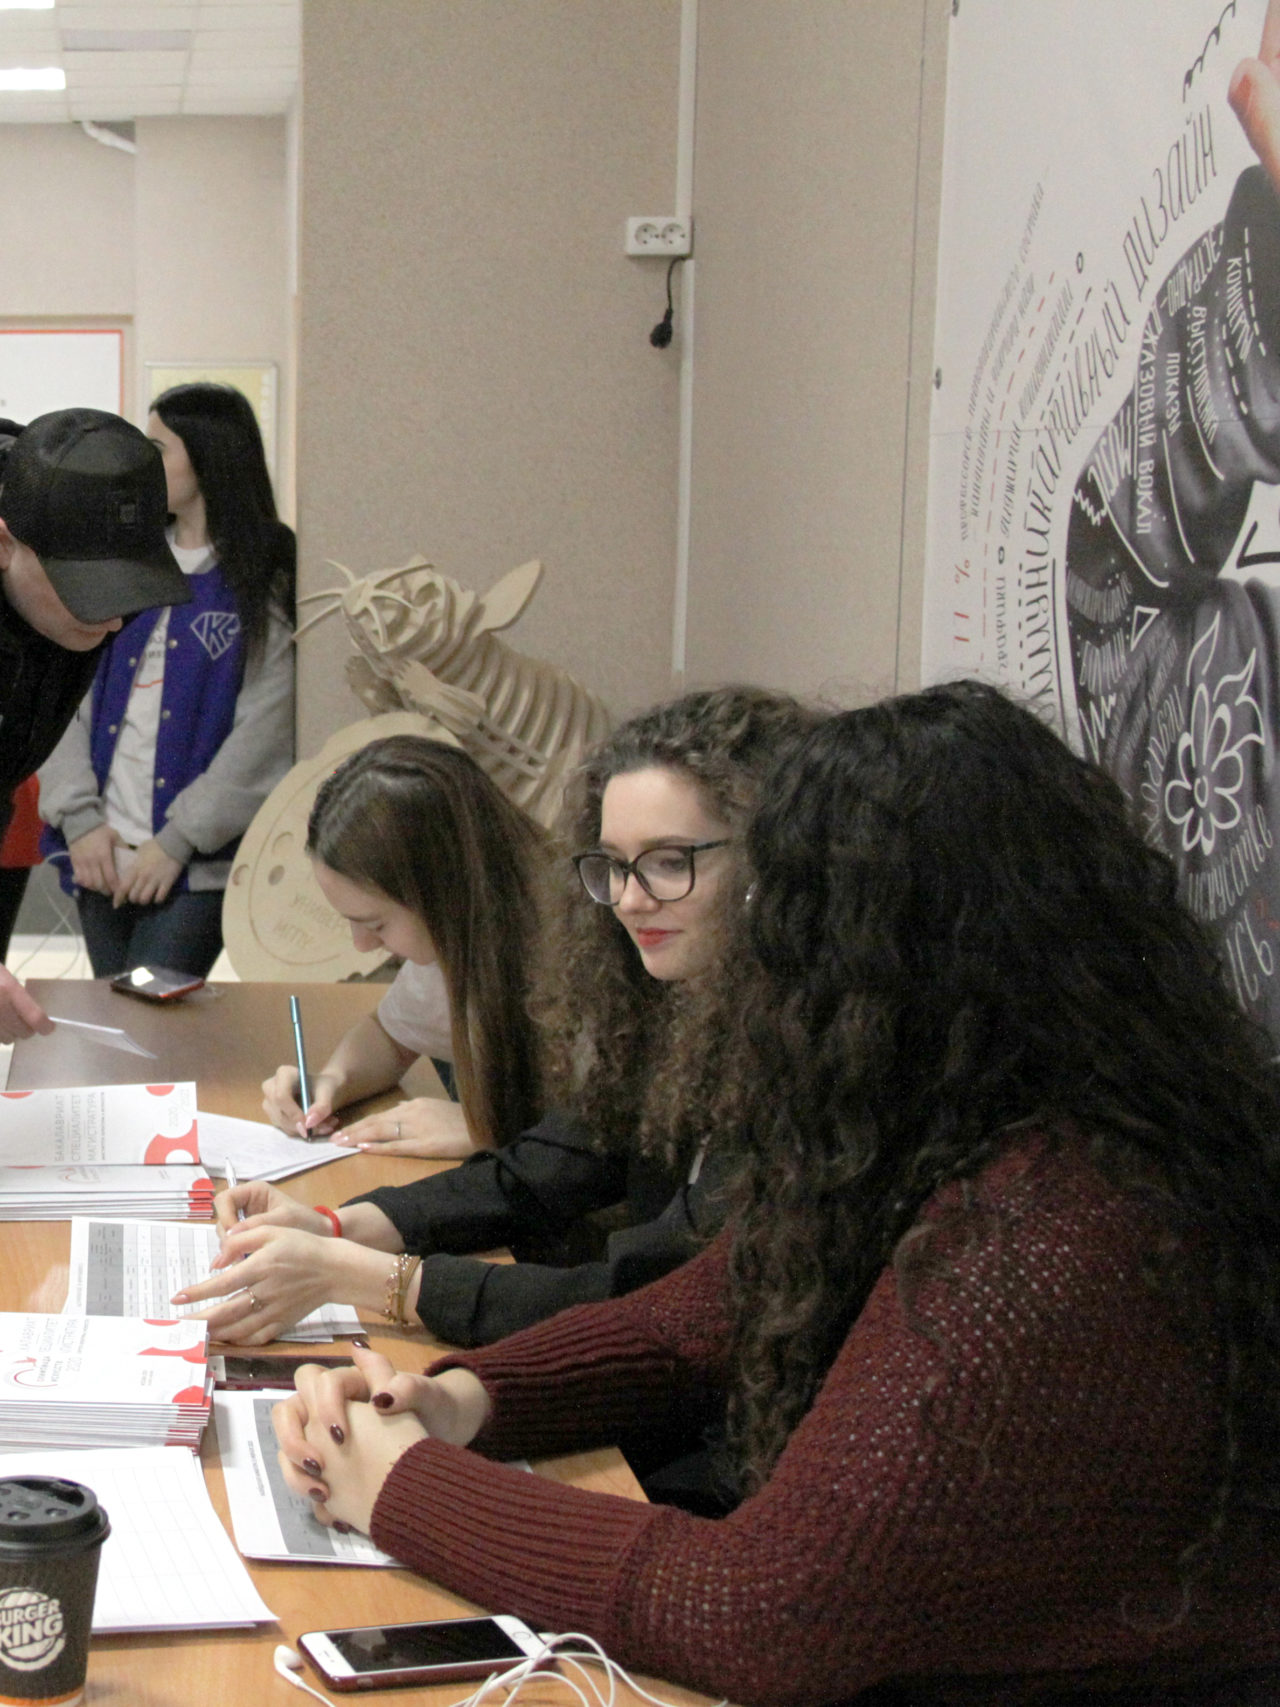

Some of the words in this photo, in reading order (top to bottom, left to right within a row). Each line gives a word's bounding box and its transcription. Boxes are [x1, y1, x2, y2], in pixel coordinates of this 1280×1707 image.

[1227, 256, 1255, 364] КОНЦЕРТЫ
[1024, 280, 1132, 728] оммуникативный
[1122, 104, 1217, 302] дизайн
[1165, 351, 1182, 437] ПОКАЗЫ
[1135, 458, 1156, 535] ВОКАЛ
[55, 1094, 65, 1163] БАКАЛАВРИАТ
[71, 1094, 82, 1162] СПЕЦИАЛИТЕТ
[88, 1092, 98, 1162] МАГИСТРАТУРА
